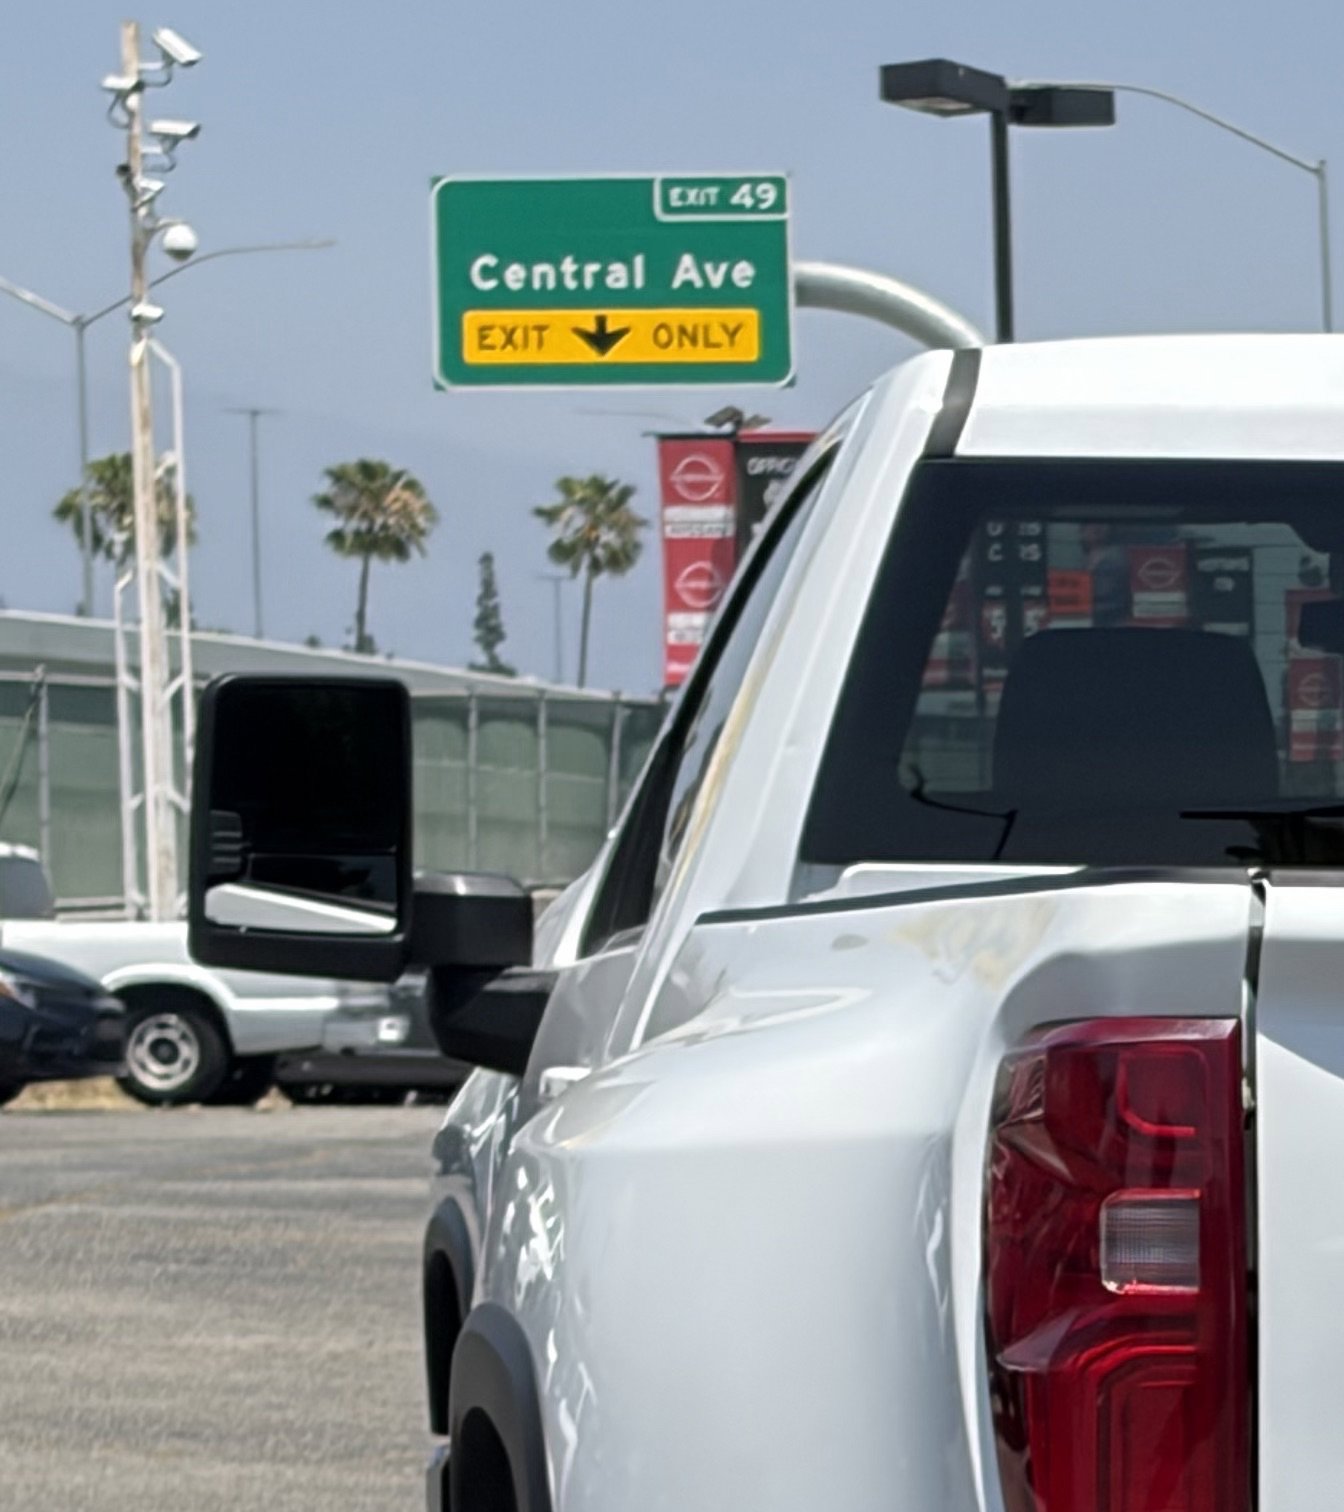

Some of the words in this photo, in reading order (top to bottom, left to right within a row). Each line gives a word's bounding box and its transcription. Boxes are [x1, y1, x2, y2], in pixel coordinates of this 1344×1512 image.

[669, 187, 719, 207] EXIT
[730, 183, 777, 210] 49
[470, 254, 646, 290] Central
[671, 253, 756, 289] Ave
[476, 324, 550, 350] EXIT
[652, 322, 744, 349] ONLY
